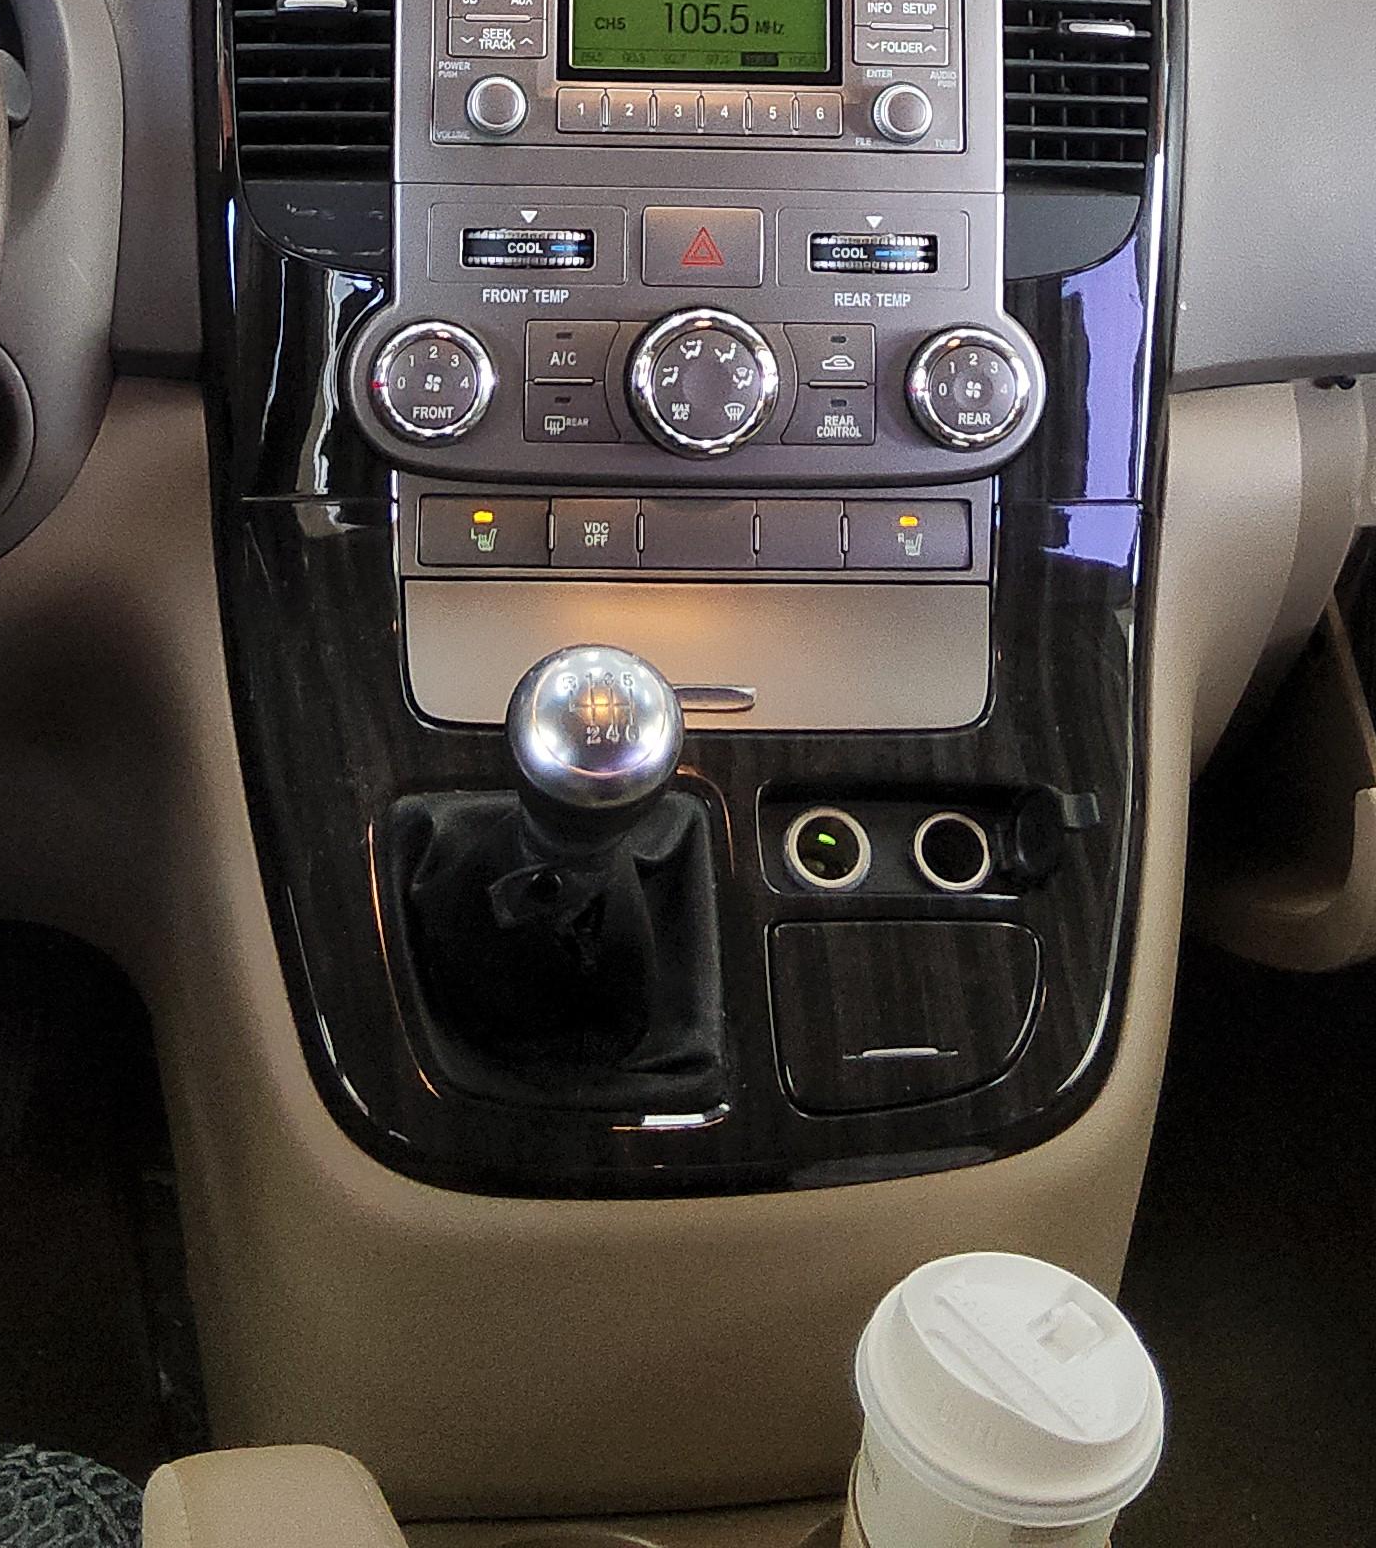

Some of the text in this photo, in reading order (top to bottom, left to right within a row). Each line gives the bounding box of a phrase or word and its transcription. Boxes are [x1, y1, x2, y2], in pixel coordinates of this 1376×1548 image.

[867, 2, 937, 15] INFO SETUP
[593, 1, 784, 35] CH5 105.5 MHz
[482, 28, 512, 39] SEEK
[478, 38, 516, 50] TRACK
[880, 41, 923, 54] FOLDER
[438, 60, 470, 71] POWER
[866, 69, 892, 79] ENTER
[930, 70, 956, 80] AUDIO
[577, 102, 584, 115] 1
[624, 103, 634, 116] 2
[673, 104, 683, 117] 3
[719, 105, 729, 118] 4
[768, 106, 778, 119] 5
[815, 107, 825, 120] 6
[855, 137, 872, 146] FILE
[507, 242, 543, 254] COOL
[831, 247, 868, 259] COOL
[482, 289, 570, 305] FRONT TEMP
[834, 292, 911, 308] REAR TEMP
[549, 351, 577, 367] A/C
[397, 345, 470, 390] 0 1 2 3 4
[938, 383, 947, 396] 0
[950, 361, 956, 374] 1
[968, 353, 978, 366] 2
[990, 361, 999, 374] 3
[412, 405, 455, 420] FRONT
[671, 403, 691, 413] MAX
[566, 417, 590, 428] REAR
[824, 415, 854, 427] REAR
[958, 412, 992, 426] REAR
[816, 425, 862, 438] CONTROL
[583, 522, 610, 534] VDC
[584, 533, 609, 546] OFF
[623, 673, 634, 687] 5
[586, 724, 602, 745] 2
[606, 723, 620, 743] 4
